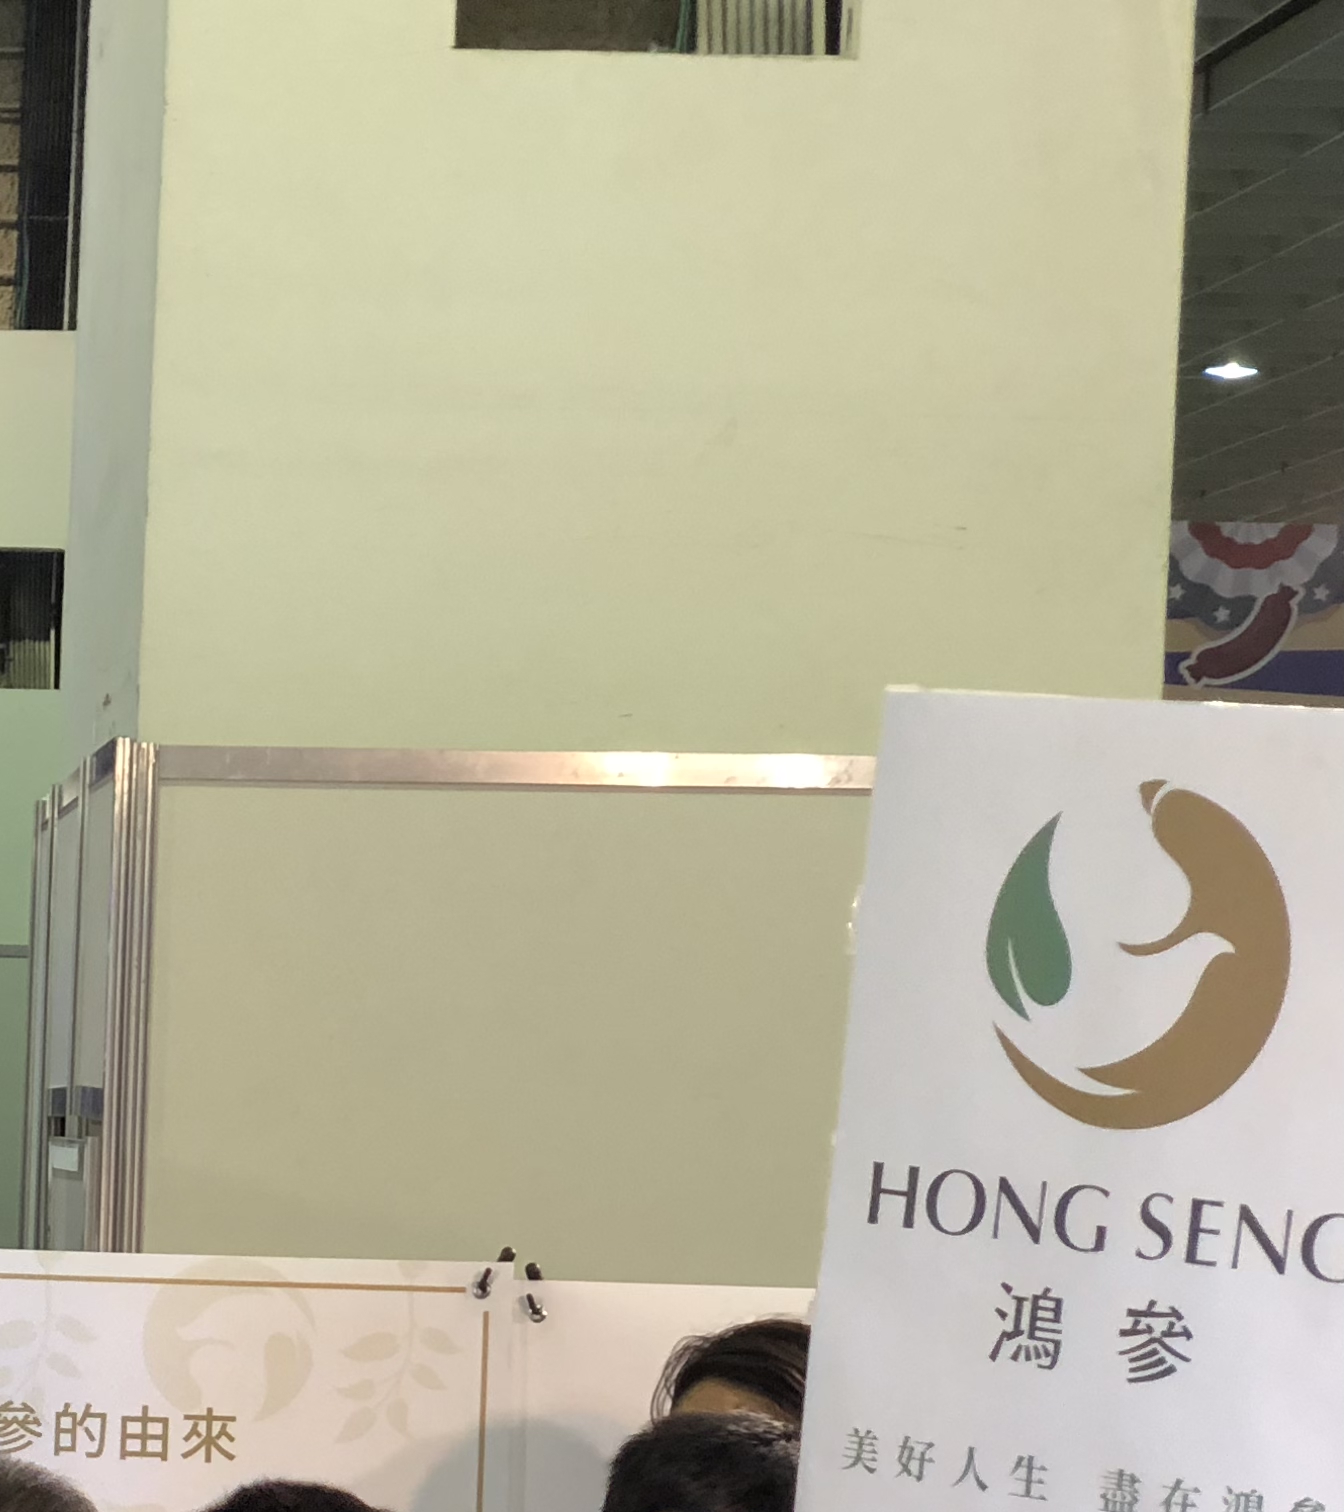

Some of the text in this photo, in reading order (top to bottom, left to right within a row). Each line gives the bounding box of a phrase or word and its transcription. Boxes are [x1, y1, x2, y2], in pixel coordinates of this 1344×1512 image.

[866, 1160, 1112, 1253] HONG
[988, 1281, 1194, 1385] 鴻參
[840, 1427, 1050, 1502] 美好人生
